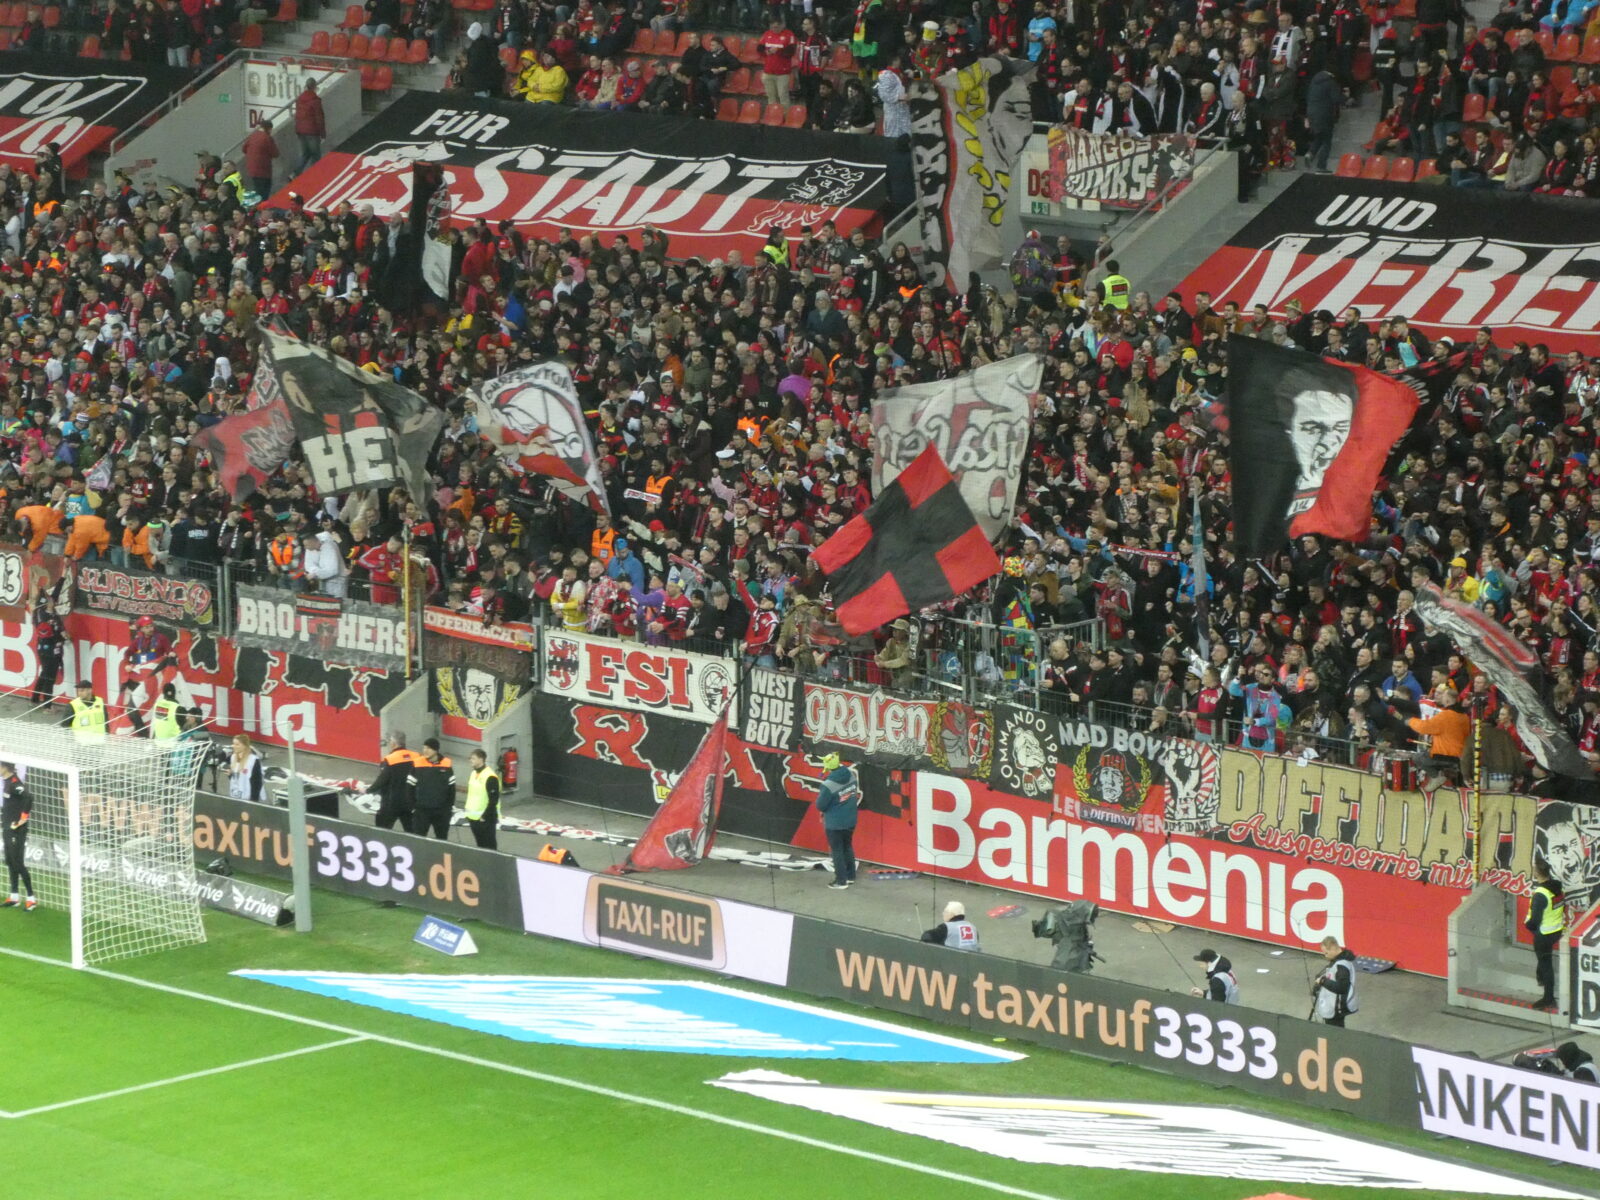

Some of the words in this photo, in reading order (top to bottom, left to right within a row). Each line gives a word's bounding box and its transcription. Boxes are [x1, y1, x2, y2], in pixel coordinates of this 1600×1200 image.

[410, 108, 510, 143] FÜR
[455, 148, 810, 231] STADT
[1315, 194, 1438, 232] UND
[78, 566, 190, 607] JUGEND
[585, 642, 693, 712] FSI
[751, 668, 797, 701] WEST
[748, 692, 795, 726] SIDE
[745, 718, 793, 750] BOYZ
[1058, 721, 1109, 748] MAD
[1043, 733, 1059, 778] 1989
[916, 771, 1345, 947] Barmenia
[245, 895, 279, 918] trive
[605, 897, 706, 948] TAXI-RUF
[835, 947, 1364, 1100] www.taxiruf3333.de
